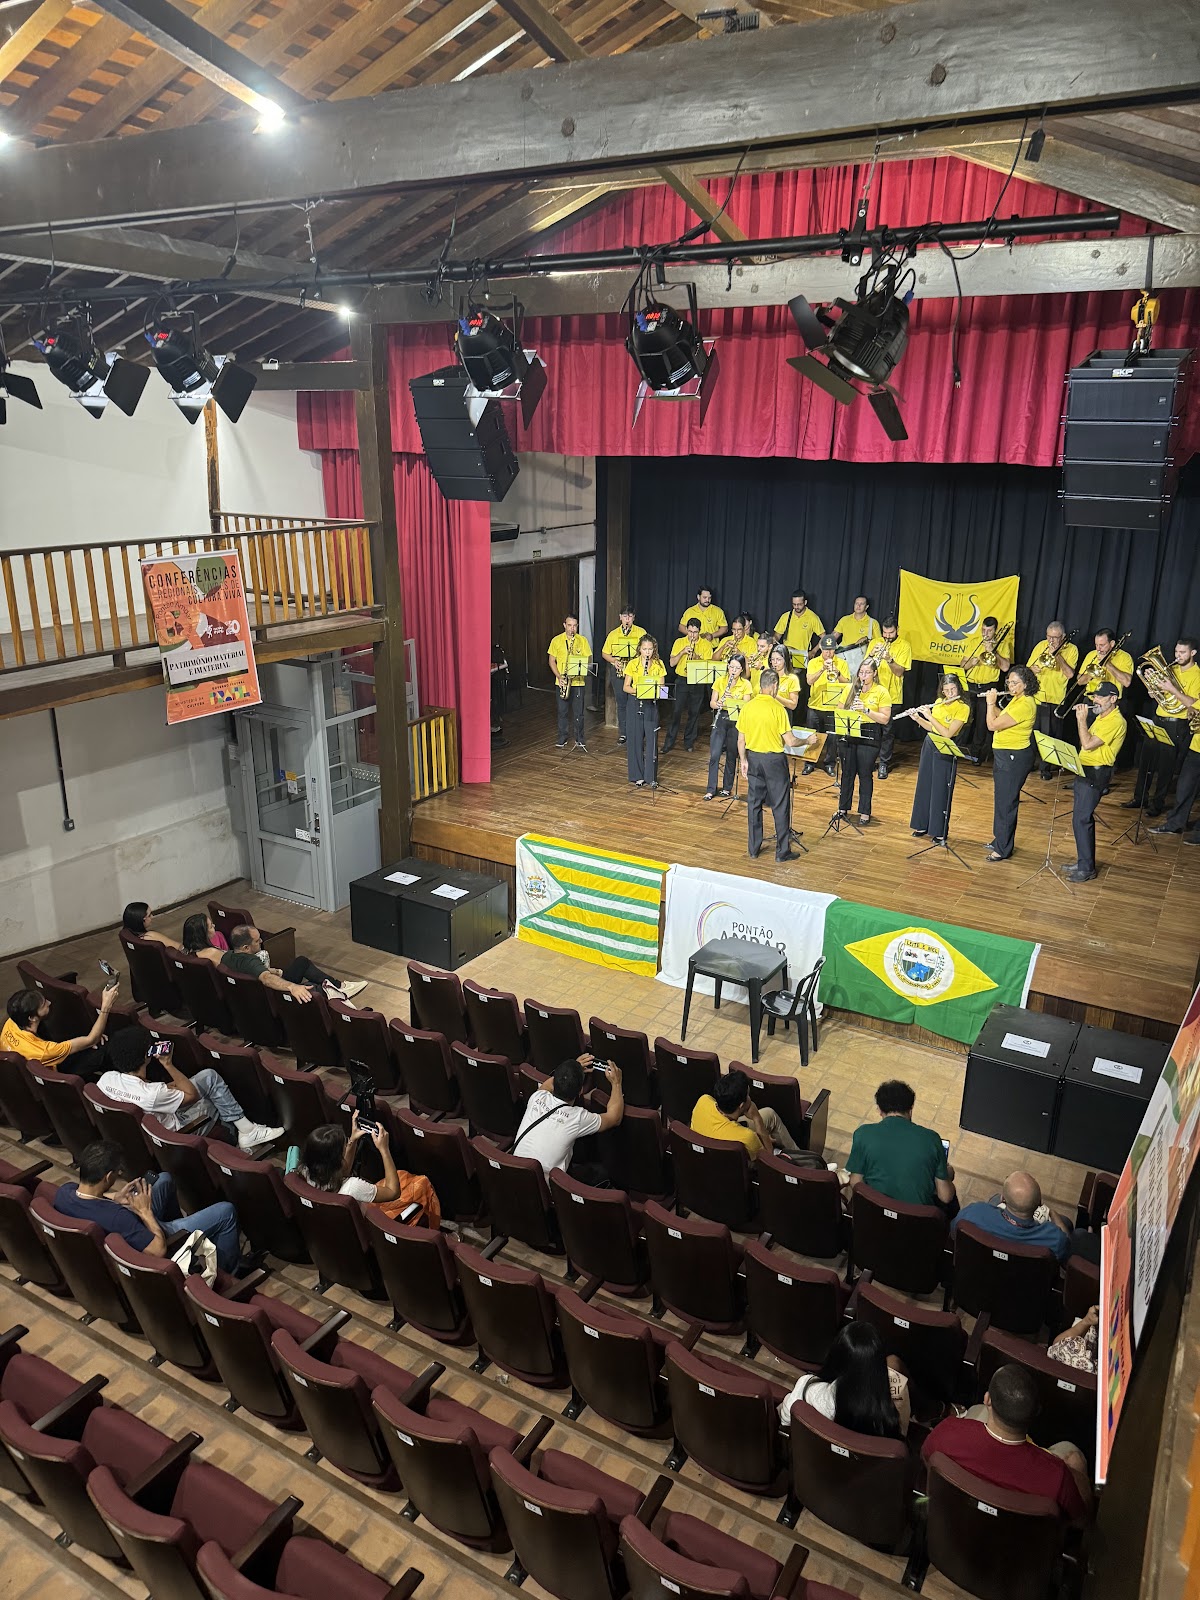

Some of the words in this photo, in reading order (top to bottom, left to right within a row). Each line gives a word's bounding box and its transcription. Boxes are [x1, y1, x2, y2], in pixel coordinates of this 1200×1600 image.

[149, 565, 238, 589] CONFERÊNCIAS
[231, 579, 240, 589] DE
[188, 592, 222, 605] CULTURA
[224, 589, 242, 600] VIVA
[929, 641, 968, 654] PHOEN
[169, 655, 213, 671] PATRIMÔNIO
[212, 650, 246, 664] MATERIAL
[194, 662, 231, 675] IMATERIAL
[732, 922, 773, 939] PONTÃO
